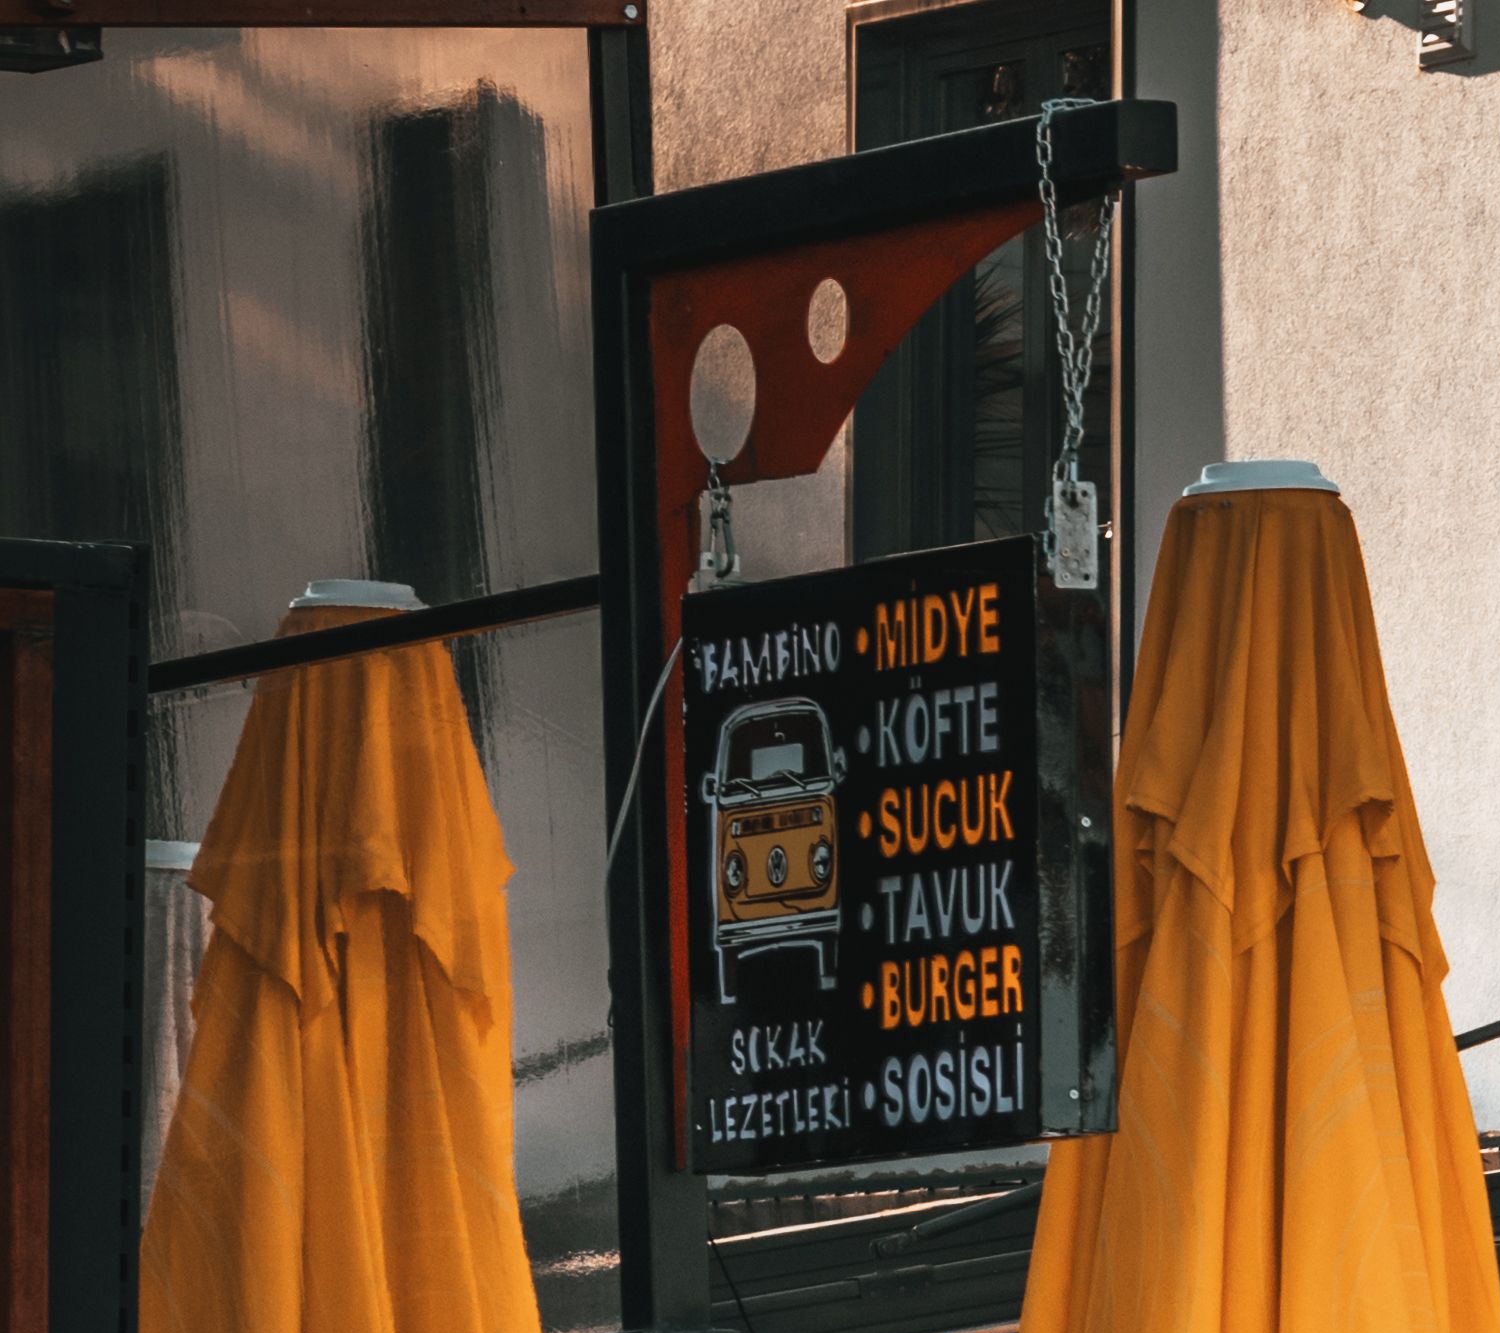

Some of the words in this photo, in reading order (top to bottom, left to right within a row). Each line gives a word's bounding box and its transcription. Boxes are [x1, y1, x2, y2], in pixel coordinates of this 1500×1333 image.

[874, 582, 999, 671] MİDYE
[876, 676, 999, 768] KÖFTE
[879, 771, 1015, 858] SUCUK
[878, 860, 1016, 945] TAVUK
[881, 945, 1023, 1029] BURGER
[884, 1023, 1025, 1127] SOSİSLİ
